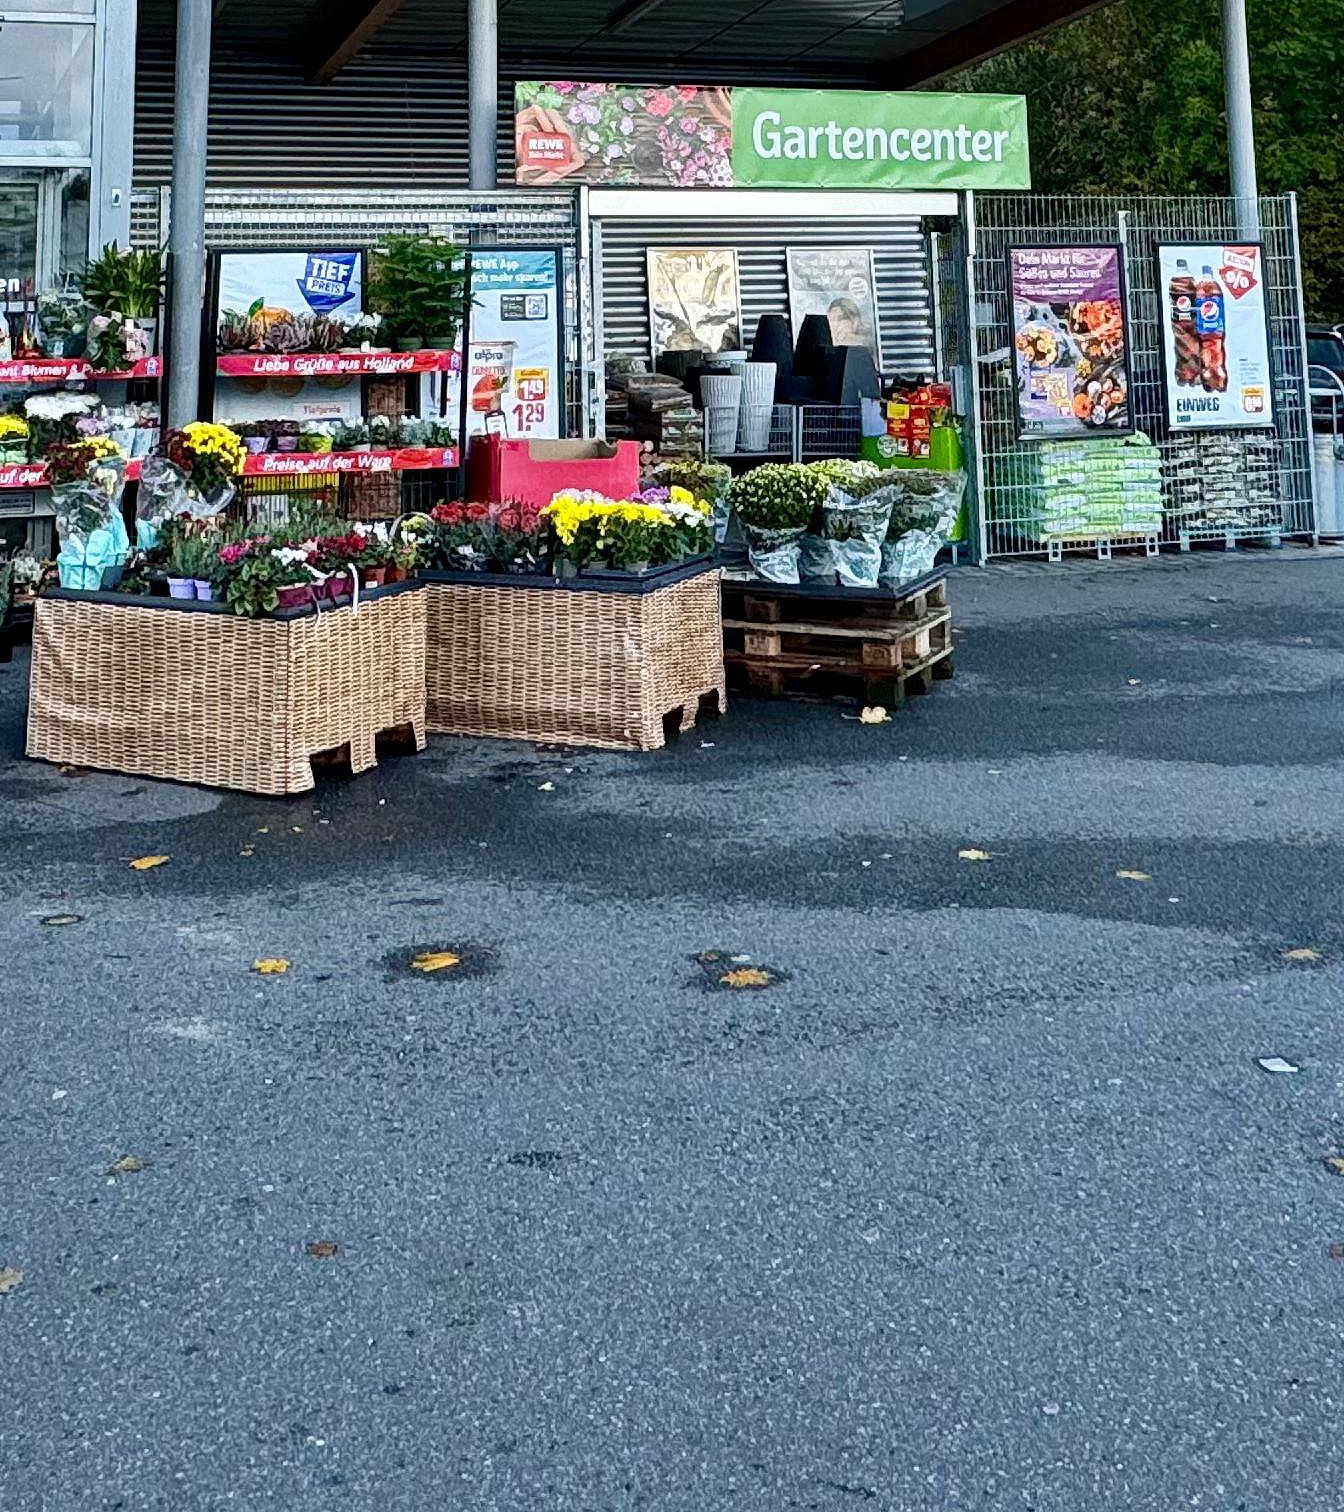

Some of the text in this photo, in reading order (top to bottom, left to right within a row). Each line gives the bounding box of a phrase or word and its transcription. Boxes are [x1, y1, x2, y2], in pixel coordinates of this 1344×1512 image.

[528, 139, 564, 150] REWE
[752, 111, 1010, 163] Gartencenter
[311, 258, 350, 282] TIEF
[310, 279, 343, 295] PREIS
[474, 348, 503, 363] alpro
[21, 363, 67, 377] Blumen
[253, 356, 290, 372] Liebe
[337, 359, 361, 370] aus
[364, 356, 415, 370] Holland
[1176, 397, 1221, 413] EINWEG
[262, 455, 393, 472] Preise auf der Ware
[18, 469, 44, 483] der
